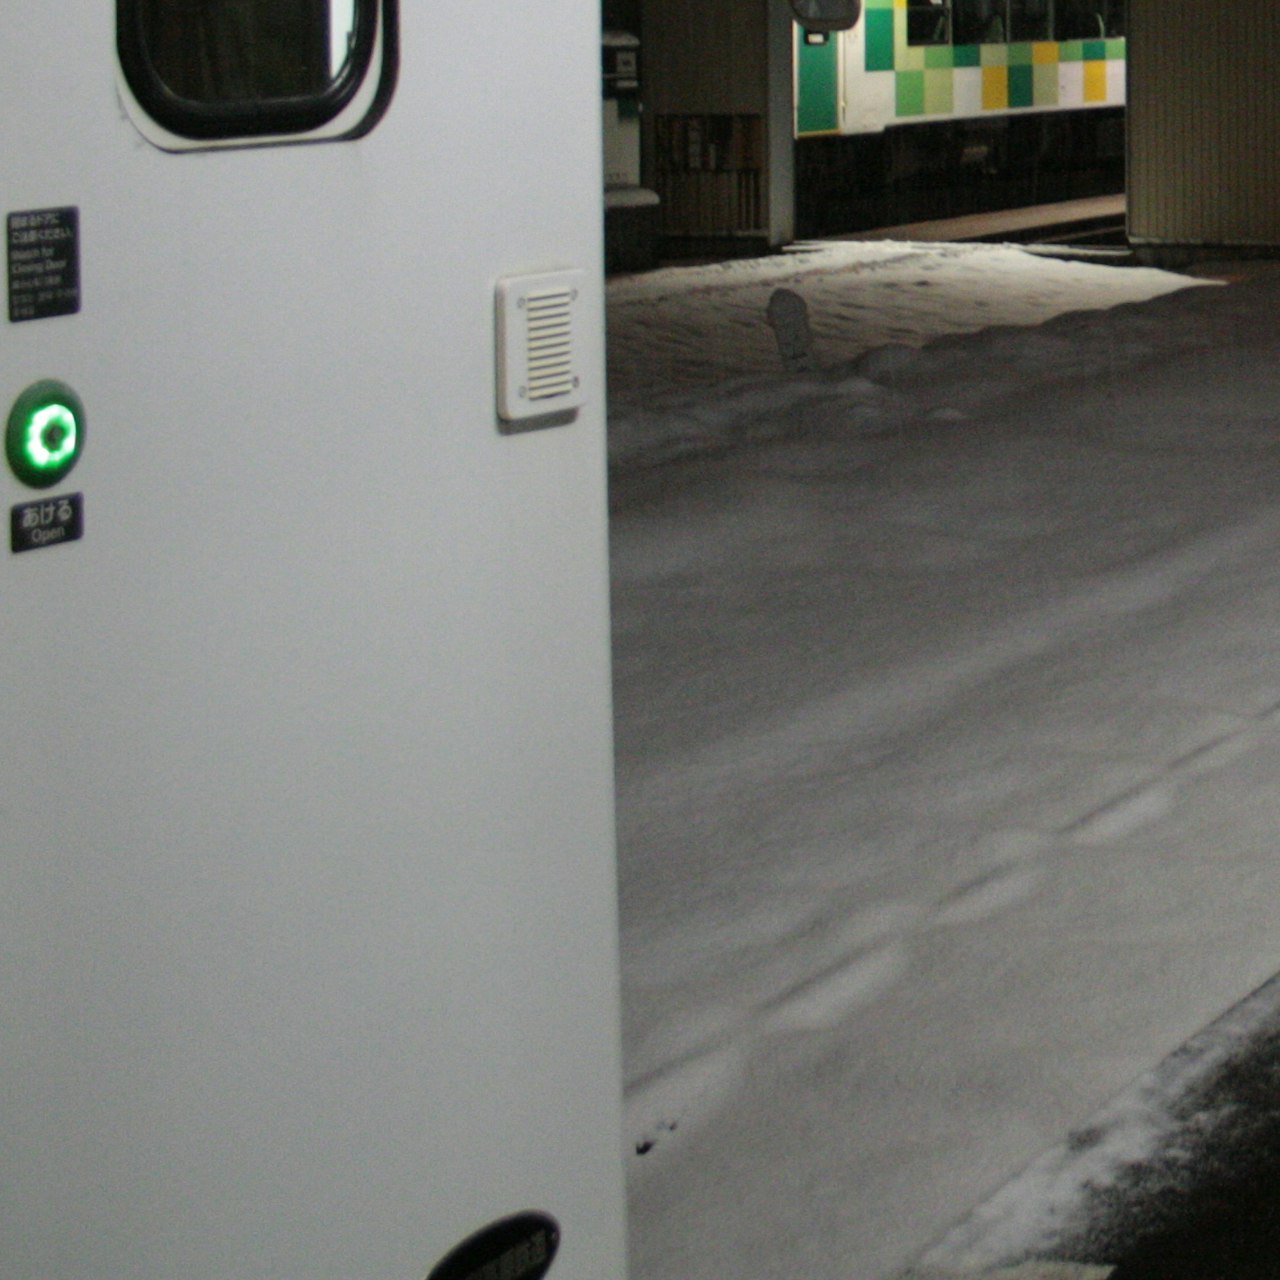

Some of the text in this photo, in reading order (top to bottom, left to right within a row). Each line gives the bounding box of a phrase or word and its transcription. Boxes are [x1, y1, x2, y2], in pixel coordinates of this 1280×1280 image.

[22, 499, 72, 528] あける
[31, 526, 66, 544] Open
